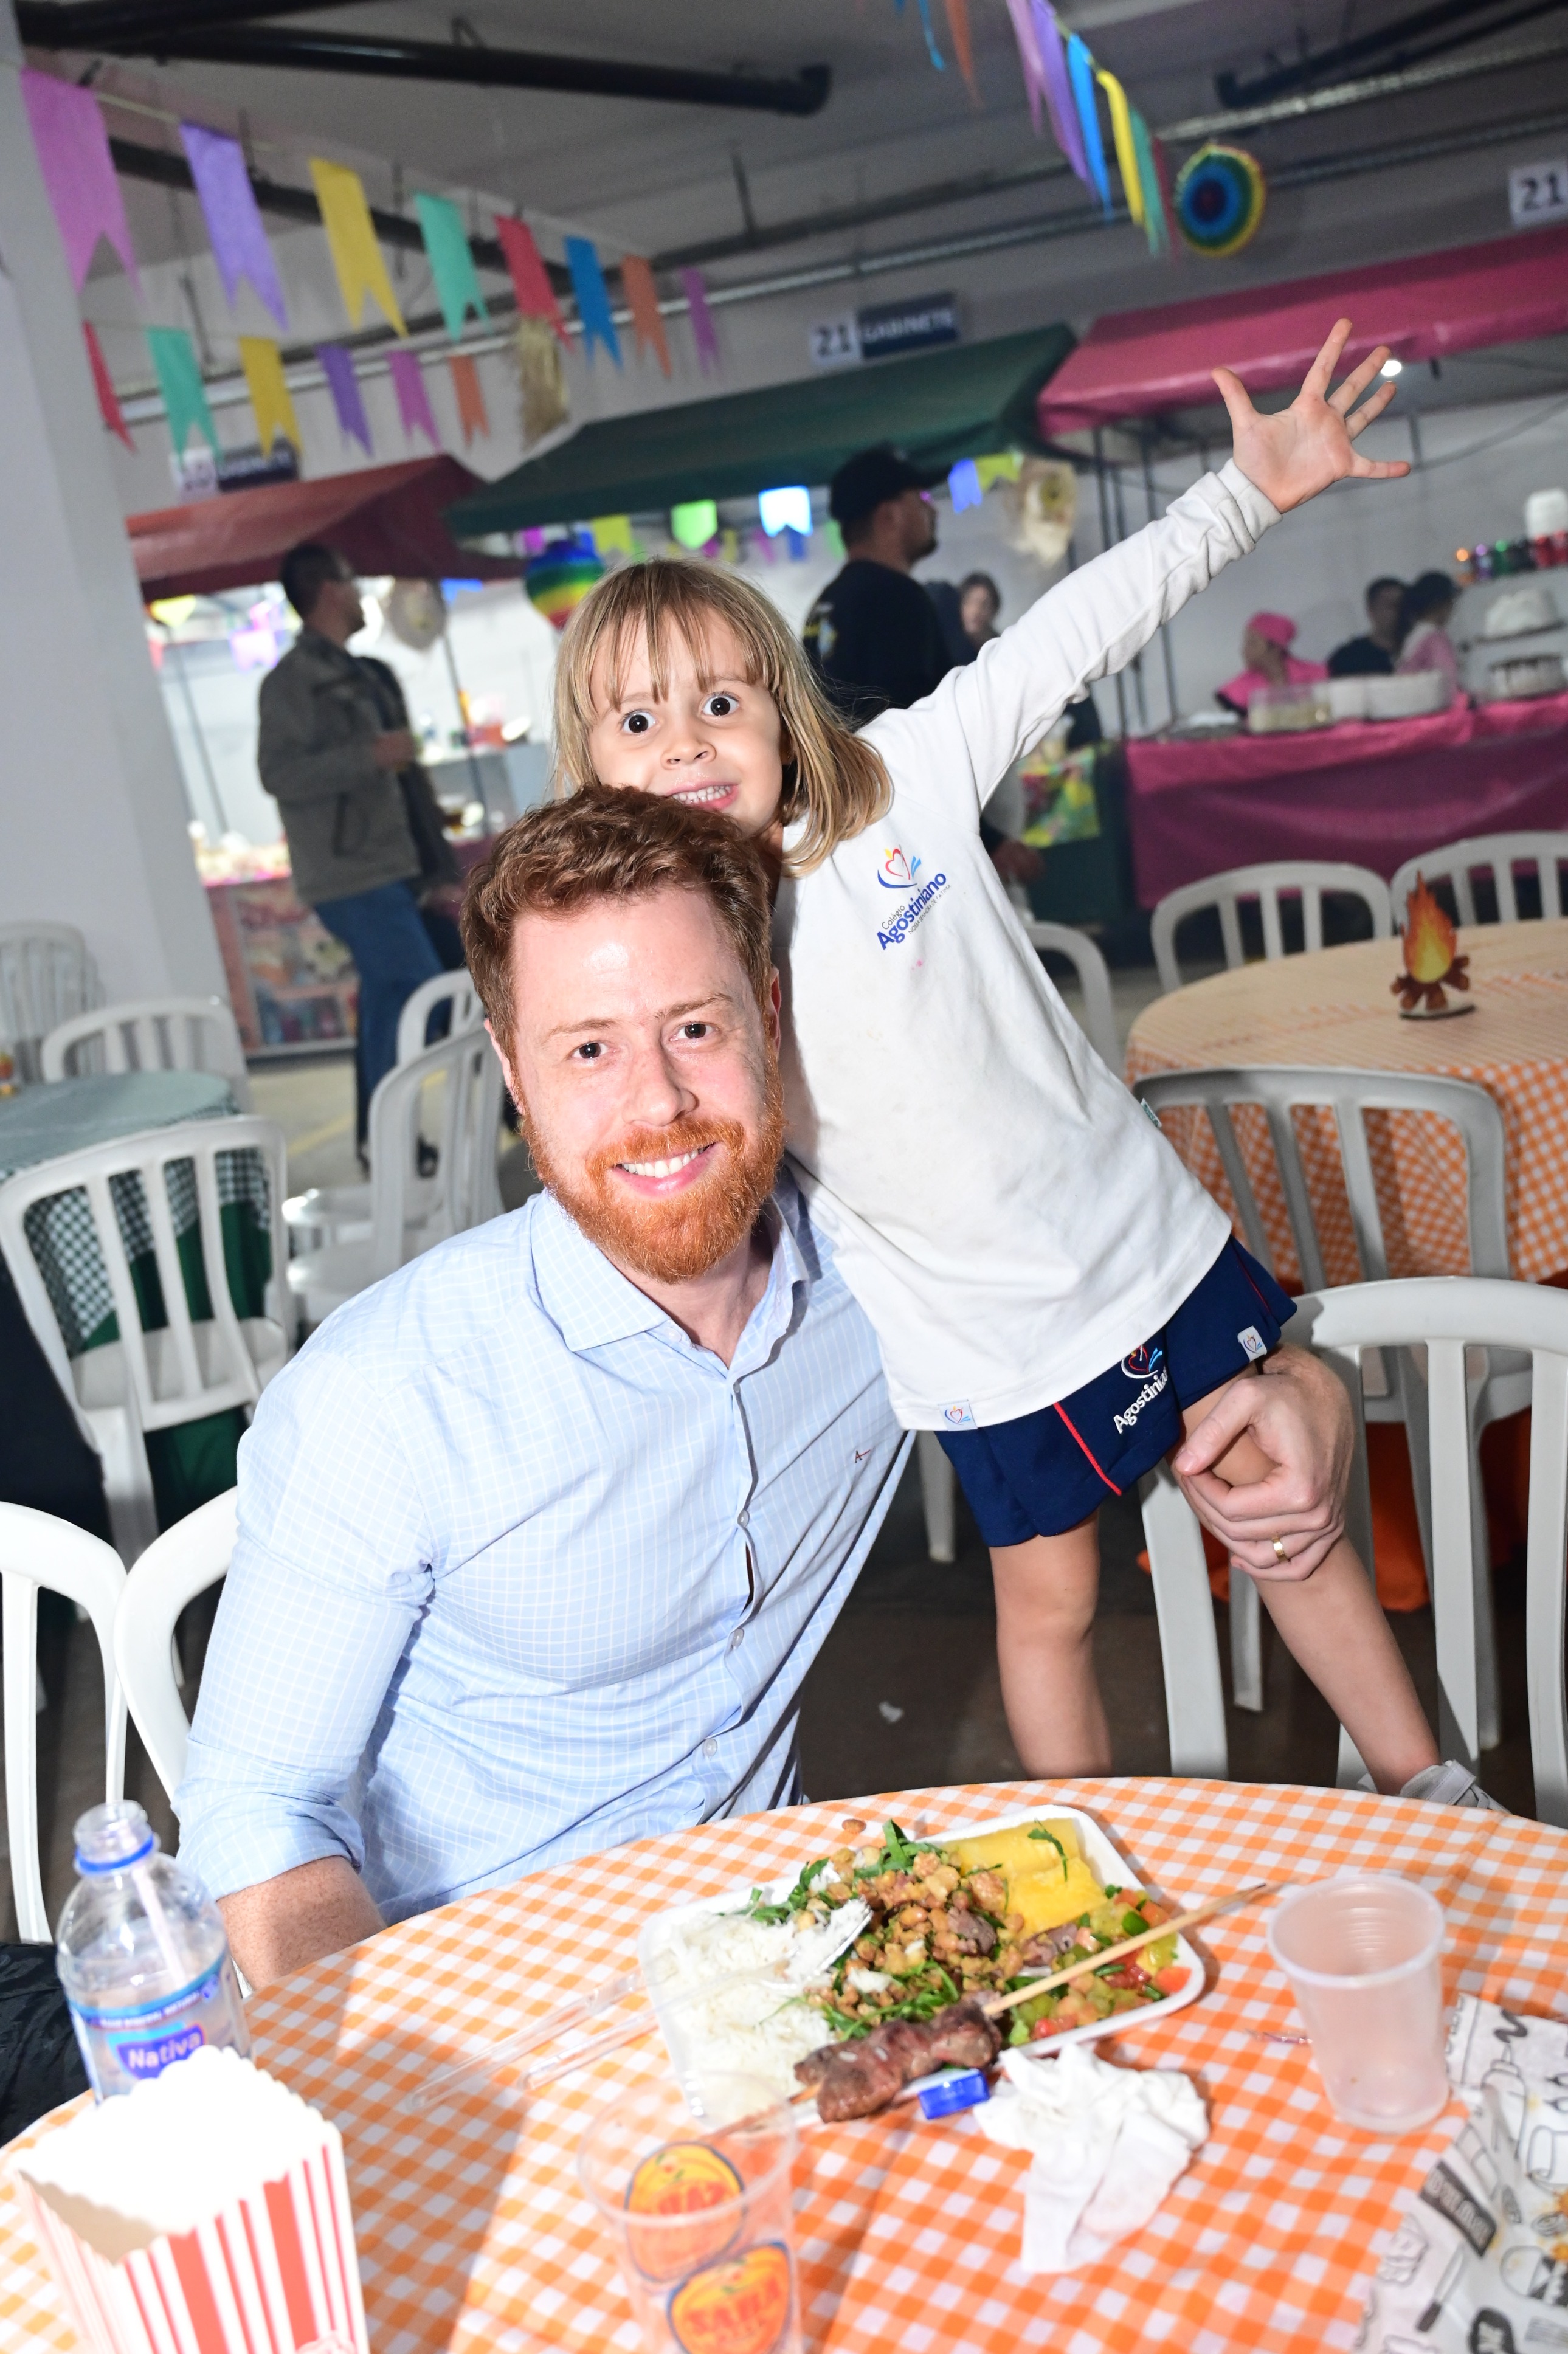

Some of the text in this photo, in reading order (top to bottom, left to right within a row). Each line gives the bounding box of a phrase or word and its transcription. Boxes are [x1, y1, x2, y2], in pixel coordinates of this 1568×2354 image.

[1521, 173, 1561, 211] 21
[818, 325, 850, 356] 21
[877, 873, 946, 950] Agostiniano
[882, 905, 905, 930] Colégio
[127, 2032, 201, 2069] Nativa
